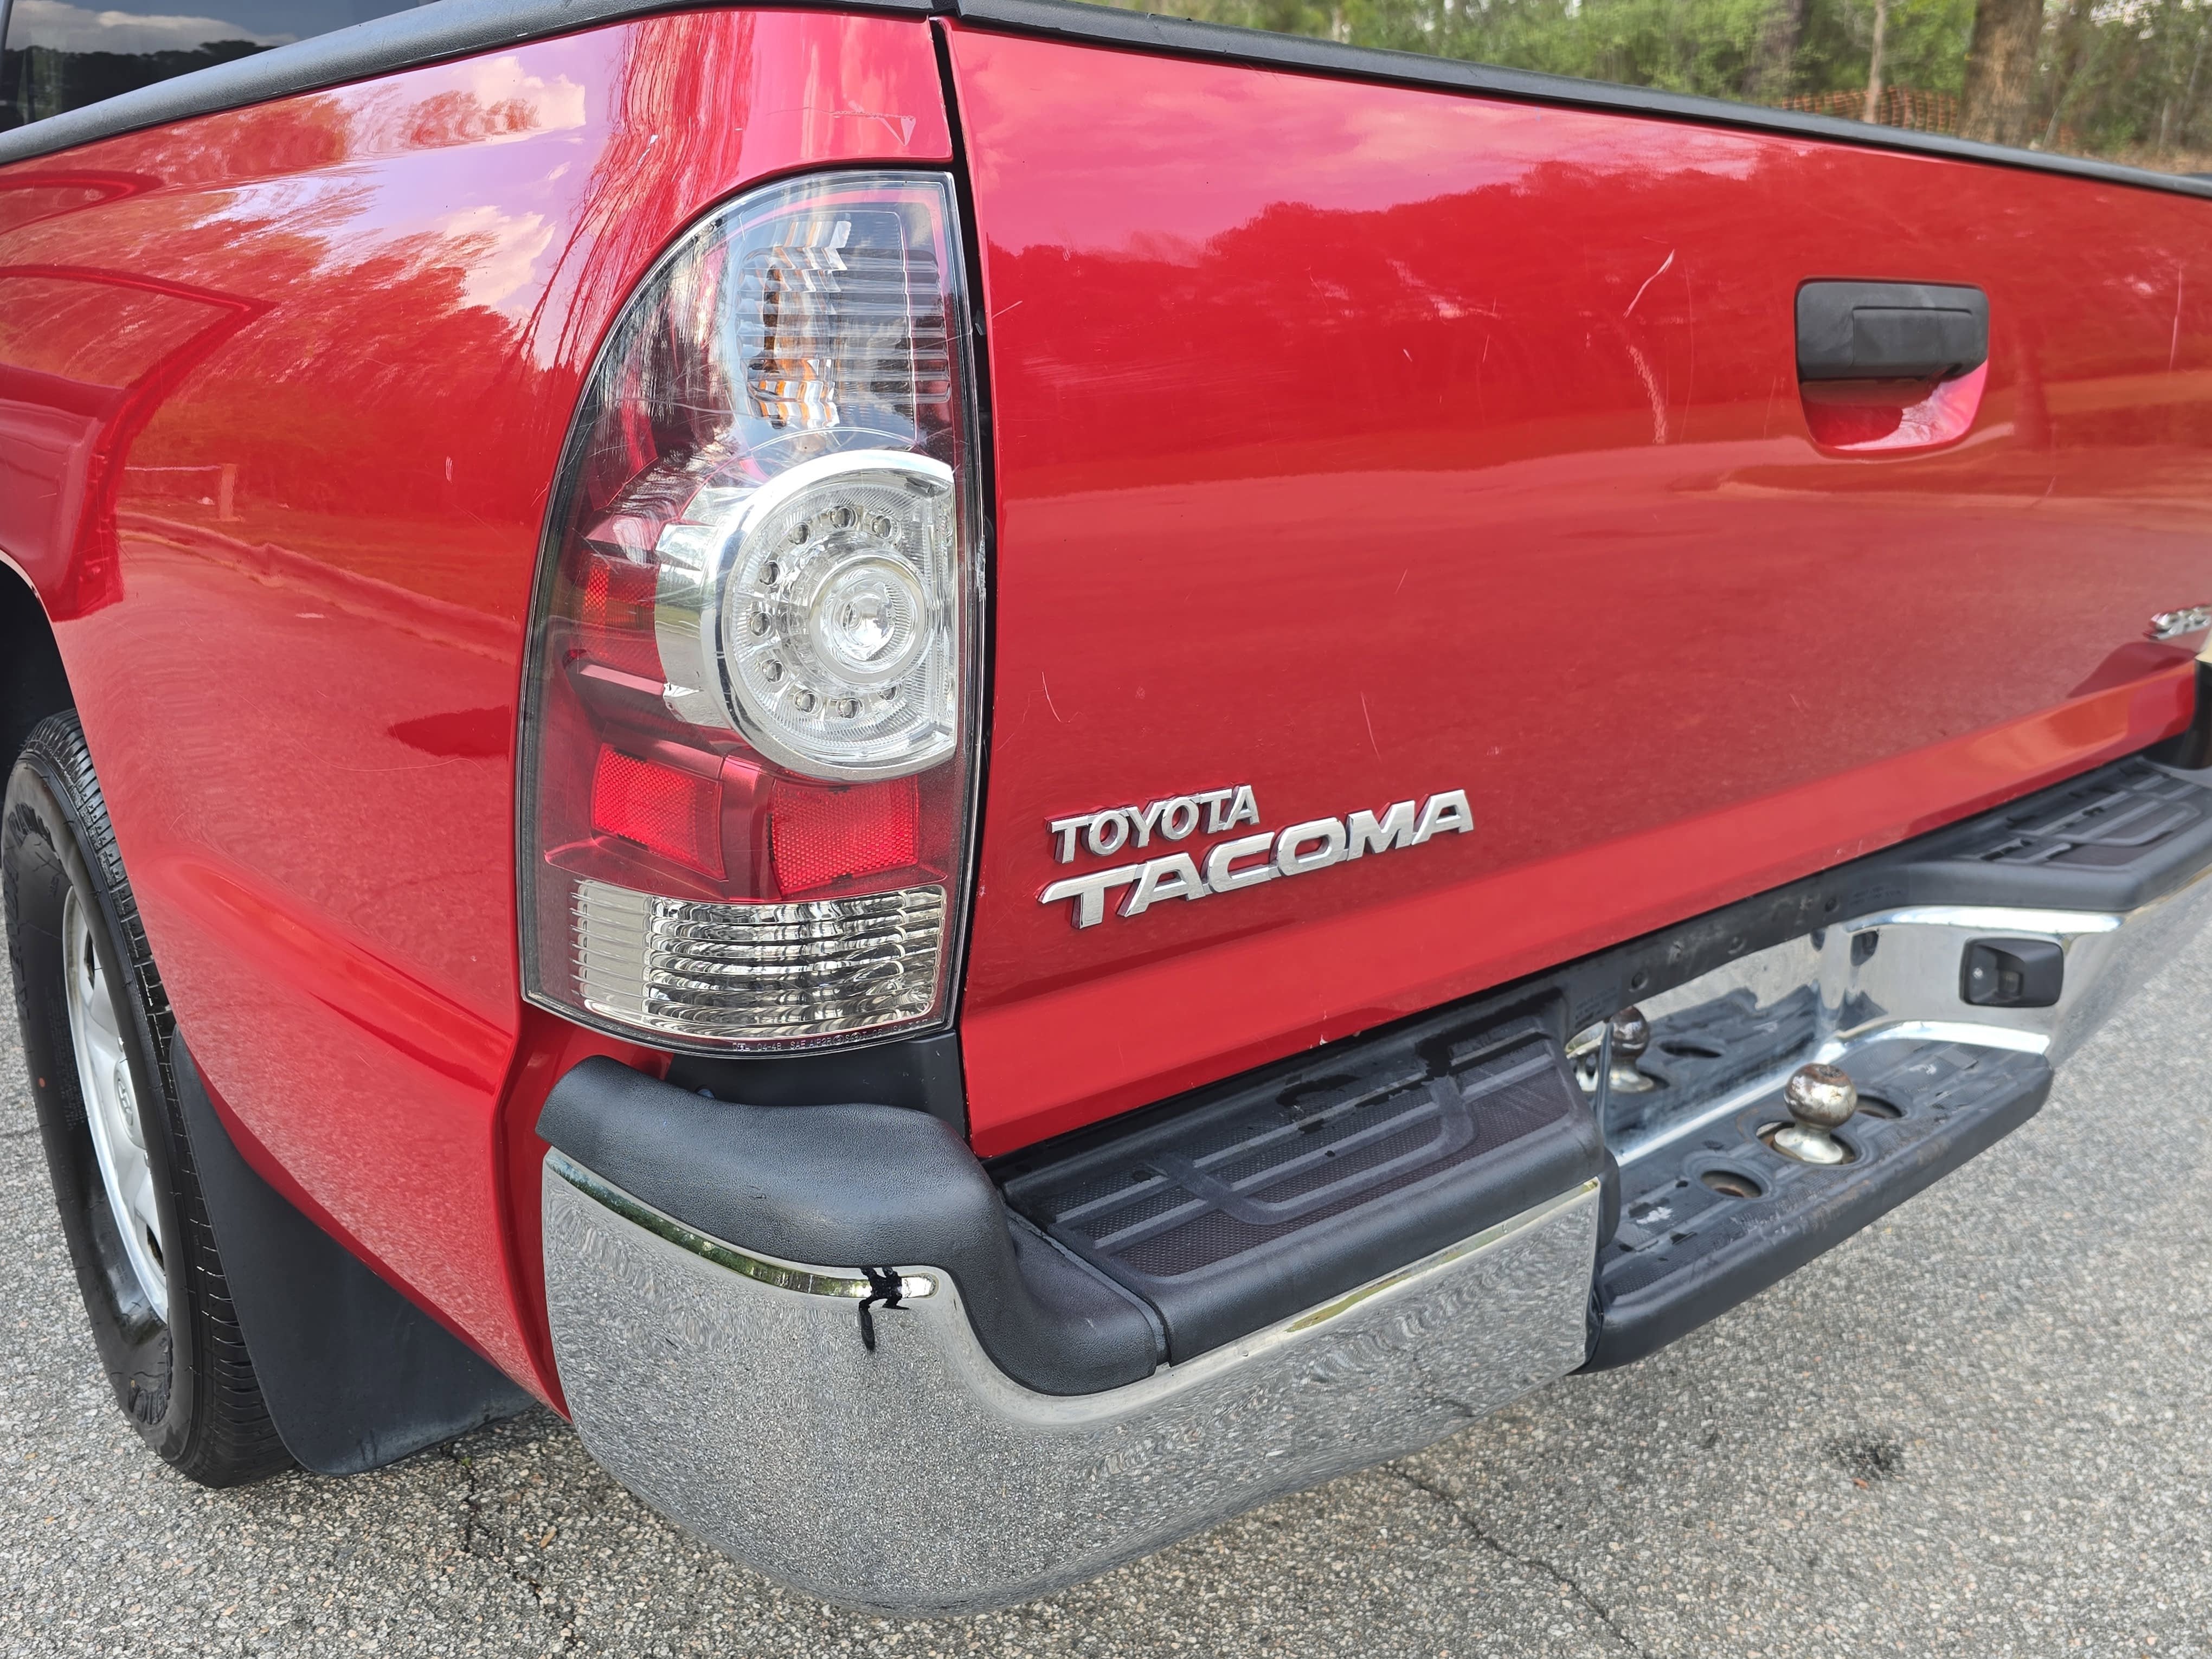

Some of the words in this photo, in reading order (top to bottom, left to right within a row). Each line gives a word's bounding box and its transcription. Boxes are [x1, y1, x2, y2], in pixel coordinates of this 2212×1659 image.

[1036, 789, 1474, 929] TACOMA
[1044, 783, 1260, 864] TOYOTA
[789, 1040, 806, 1050] SAE
